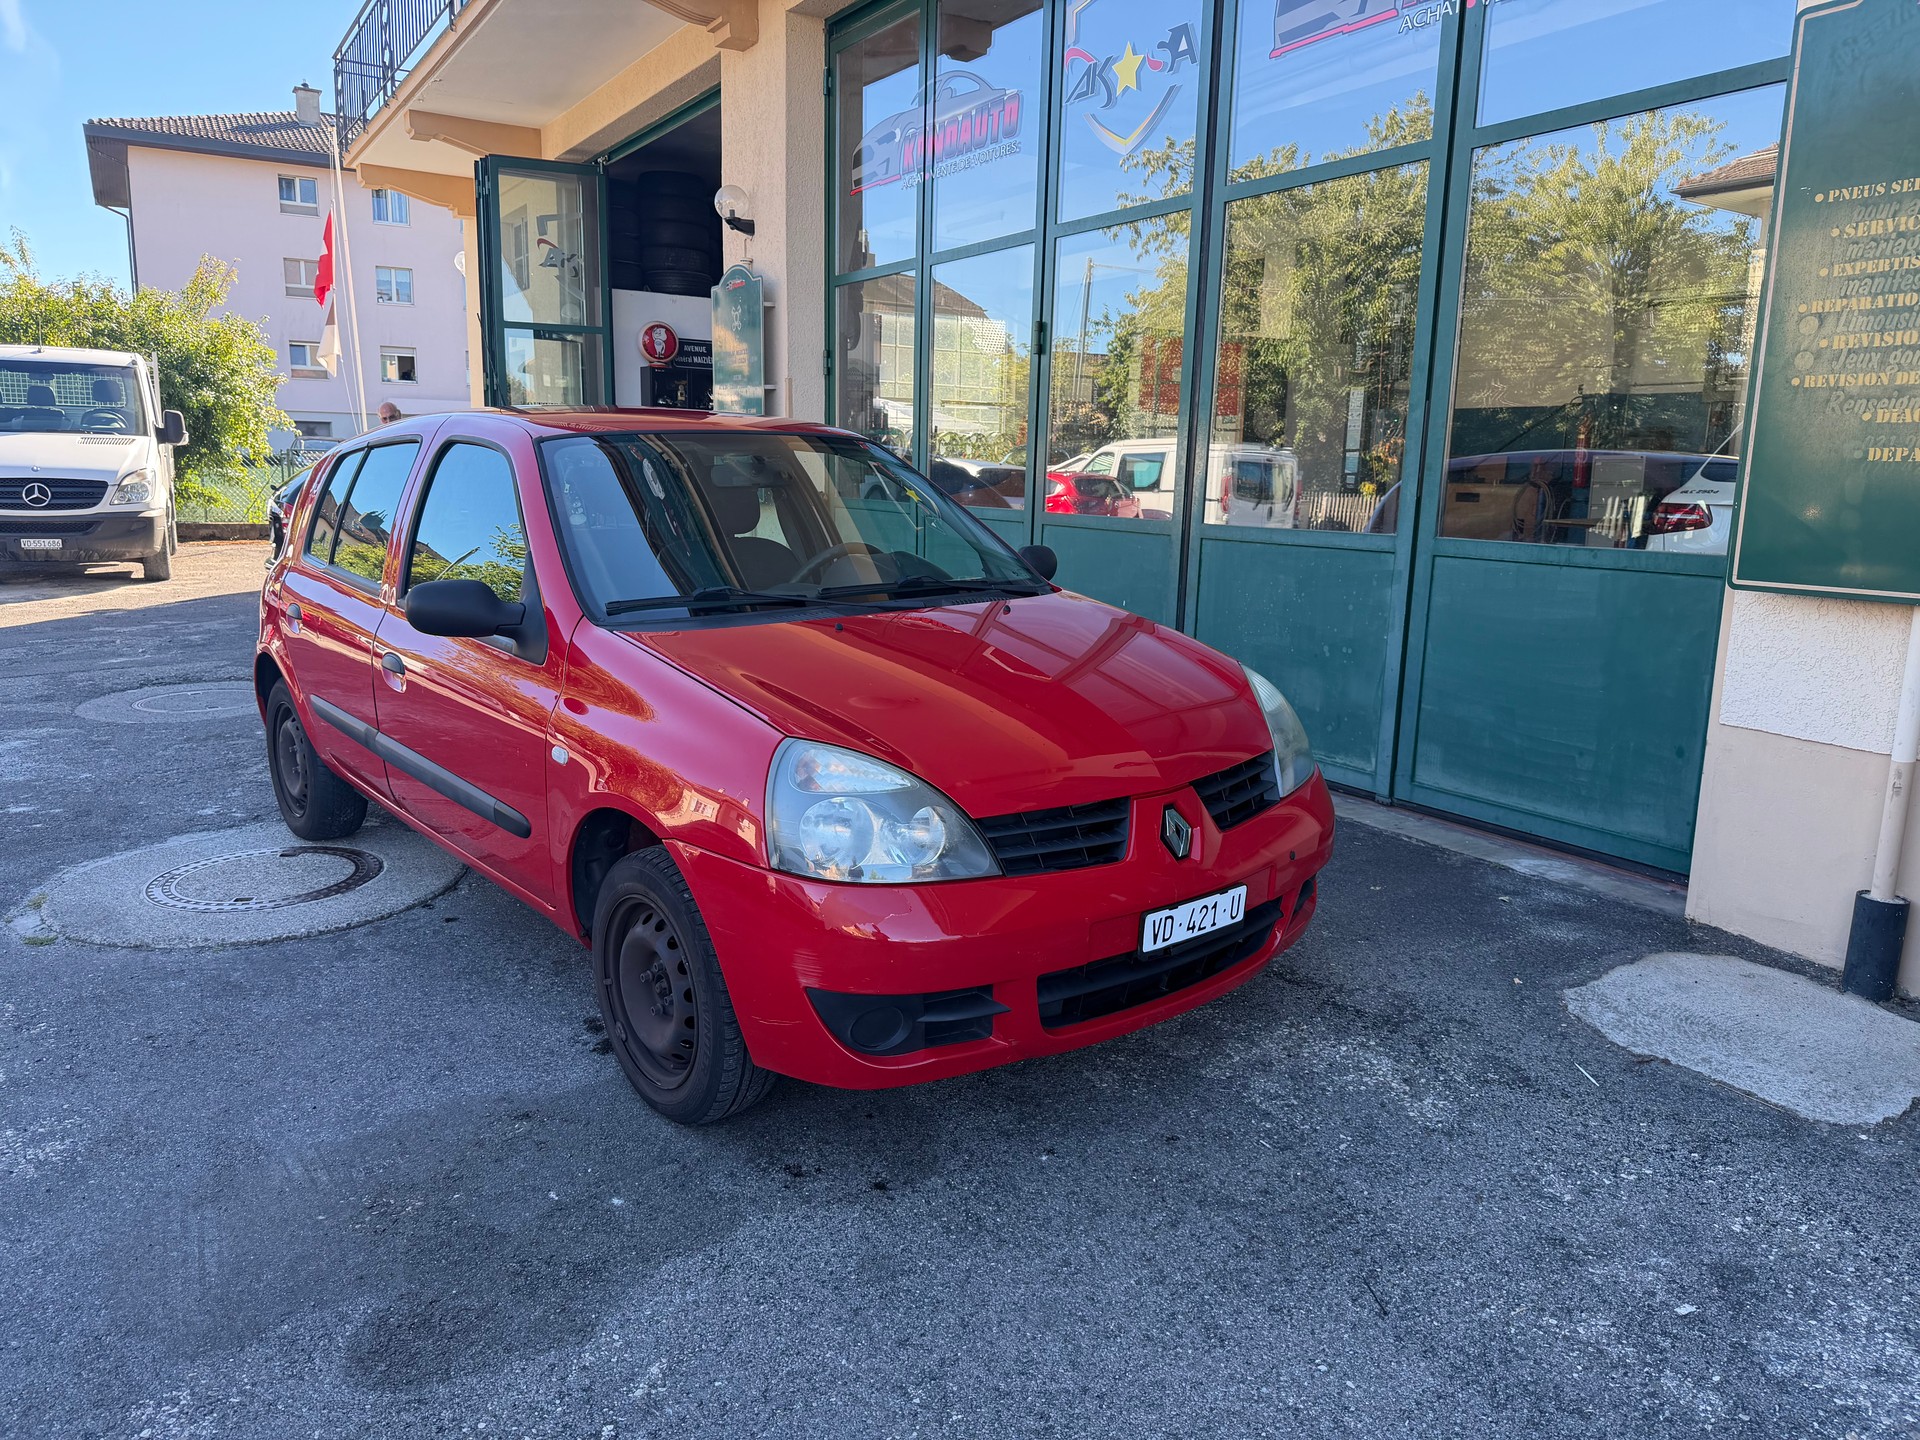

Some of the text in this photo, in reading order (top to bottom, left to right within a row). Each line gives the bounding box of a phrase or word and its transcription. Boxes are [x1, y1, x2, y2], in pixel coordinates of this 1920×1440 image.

[1828, 182, 1886, 203] PNEUS
[684, 345, 707, 353] AVENUE
[1804, 371, 1890, 388] REVISION
